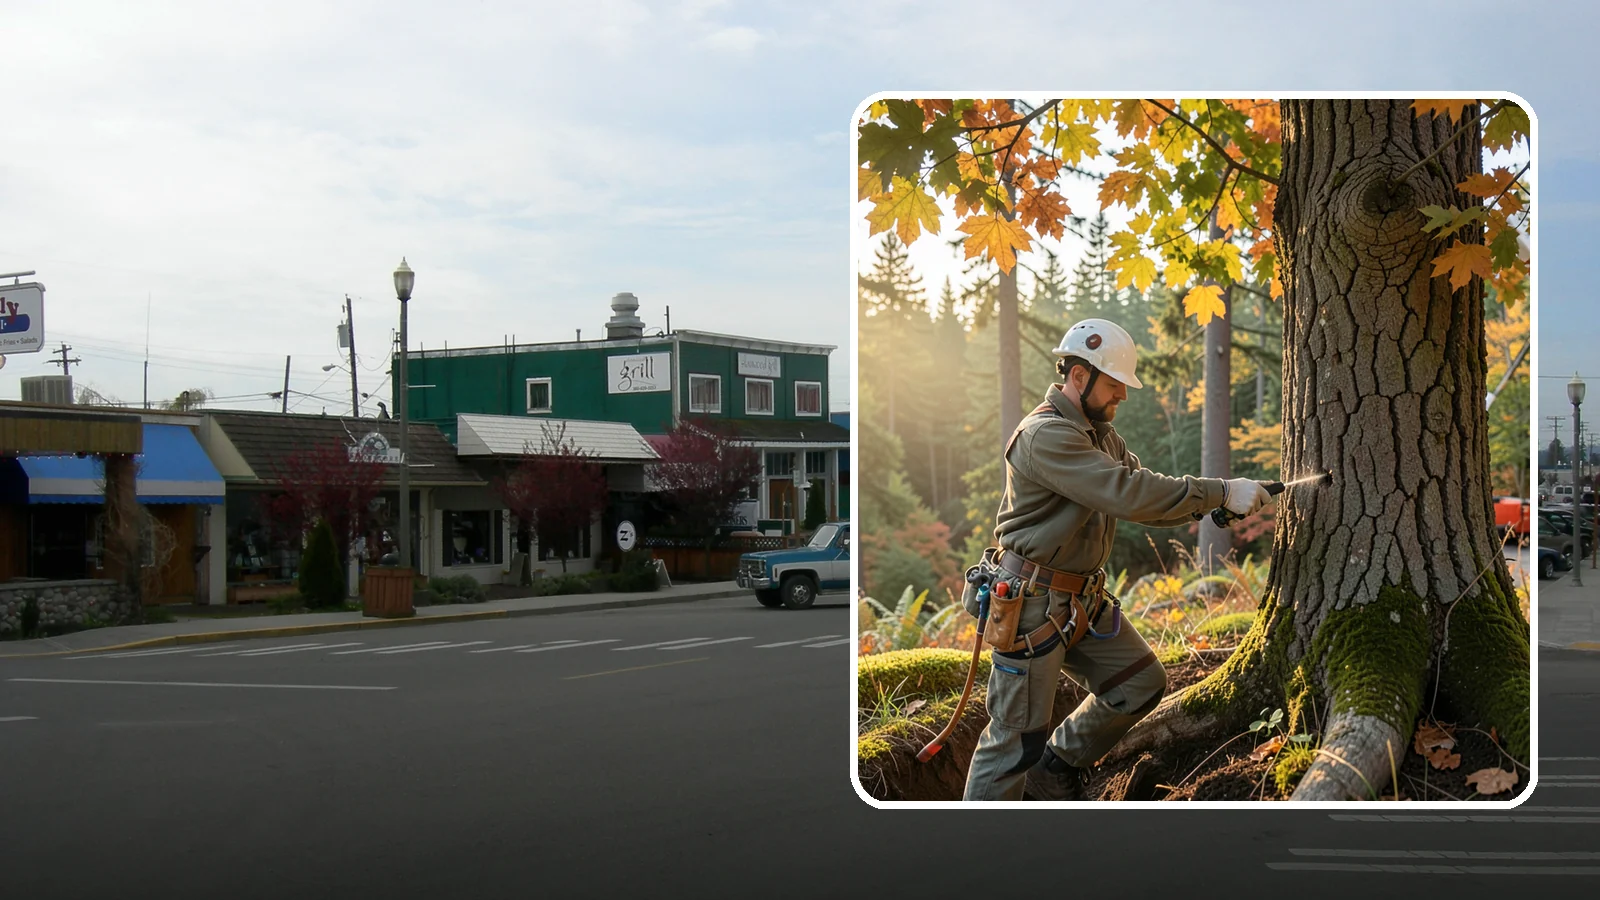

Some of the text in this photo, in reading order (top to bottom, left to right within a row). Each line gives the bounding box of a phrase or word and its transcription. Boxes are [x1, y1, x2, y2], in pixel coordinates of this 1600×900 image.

[0, 296, 19, 324] ly
[20, 337, 38, 345] Salads
[618, 356, 655, 391] grill
